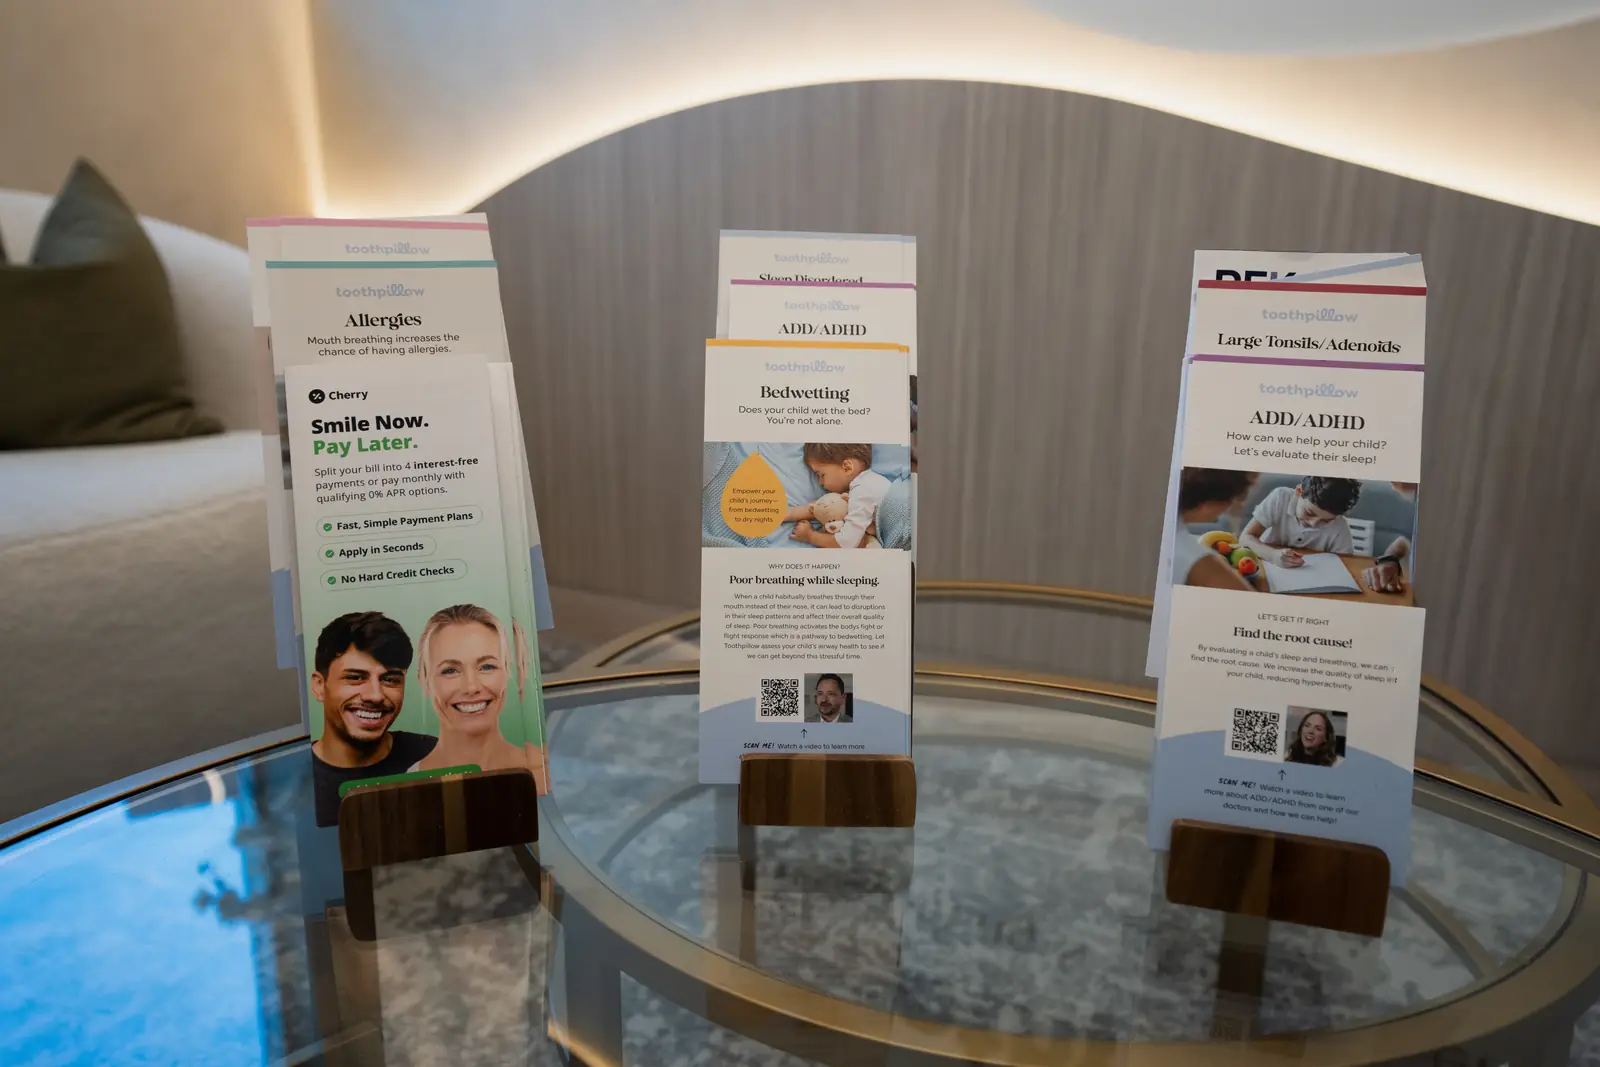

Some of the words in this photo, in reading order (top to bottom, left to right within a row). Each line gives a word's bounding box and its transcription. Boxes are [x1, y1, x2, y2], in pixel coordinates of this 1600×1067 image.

[344, 242, 430, 256] toothpillow
[774, 252, 850, 265] toothpillow
[336, 283, 425, 300] toothpillow
[784, 299, 861, 312] toothpillow
[345, 313, 422, 330] Allergies
[1262, 308, 1358, 324] toothpillow
[779, 323, 867, 336] ADD/ADHD
[308, 335, 342, 345] Mouth
[344, 334, 393, 346] breathing
[395, 334, 442, 343] increases
[443, 333, 460, 342] the
[1218, 333, 1262, 350] Large
[1265, 335, 1401, 353] Tonsils/Adenoids
[318, 347, 356, 356] chance
[358, 346, 369, 356] of
[371, 346, 405, 356] having
[408, 344, 451, 355] allergies.
[765, 360, 845, 374] toothpillow
[329, 391, 368, 401] Cherry
[761, 386, 850, 403] Bedwetting
[1259, 383, 1359, 399] toothpillow
[739, 405, 762, 414] Does
[830, 406, 846, 415] the
[848, 407, 871, 416] bed?
[311, 416, 370, 435] Smile
[375, 415, 429, 431] Now.
[815, 417, 843, 426] alone.
[1249, 411, 1365, 430] ADD/ADHD
[313, 440, 352, 458] Pay
[357, 437, 418, 452] Later.
[1227, 431, 1251, 441] How
[1296, 436, 1321, 447] help
[1324, 439, 1350, 448] your
[1352, 439, 1387, 450] child?
[1234, 446, 1259, 456] Let's
[1262, 449, 1310, 460] evaluate
[1312, 452, 1339, 462] their
[1342, 454, 1376, 466] sleep!
[314, 468, 336, 478] Split
[339, 467, 362, 477] your
[365, 464, 380, 473] bill
[383, 463, 402, 471] into
[404, 462, 411, 470] 4
[414, 457, 479, 470] interest-free
[316, 480, 365, 492] payments
[381, 478, 400, 487] pay
[402, 473, 442, 484] monthly
[444, 470, 465, 480] with
[317, 492, 367, 505] qualifying
[368, 490, 384, 499] 0%
[386, 488, 406, 498] APR
[408, 486, 448, 498] options.
[337, 522, 361, 530] Fast,
[364, 518, 398, 529] Simple
[400, 515, 445, 527] Payment
[447, 513, 474, 522] Plans
[339, 547, 368, 559] Apply
[371, 546, 381, 554] in
[383, 542, 424, 553] Seconds
[341, 575, 356, 584] No
[359, 572, 384, 582] Hard
[386, 569, 417, 580] Credit
[419, 566, 455, 577] Checks
[730, 575, 754, 584] Poor
[755, 575, 805, 587] breathing
[807, 576, 835, 585] while
[836, 576, 880, 587] sleeping.
[1258, 613, 1278, 622] LET'S
[1306, 618, 1330, 626] RIGHT
[1234, 627, 1261, 639] Find
[1263, 630, 1283, 641] the
[1285, 635, 1310, 644] root
[1313, 638, 1352, 648] cause!
[1198, 644, 1208, 652] By
[1209, 646, 1247, 656] evaluating
[1256, 650, 1279, 659] child's
[1280, 653, 1302, 662] sleep
[1267, 675, 1300, 685] reducing
[1301, 678, 1352, 690] hyperactivity
[1218, 778, 1239, 786] SCAN
[1260, 784, 1284, 792] Watch
